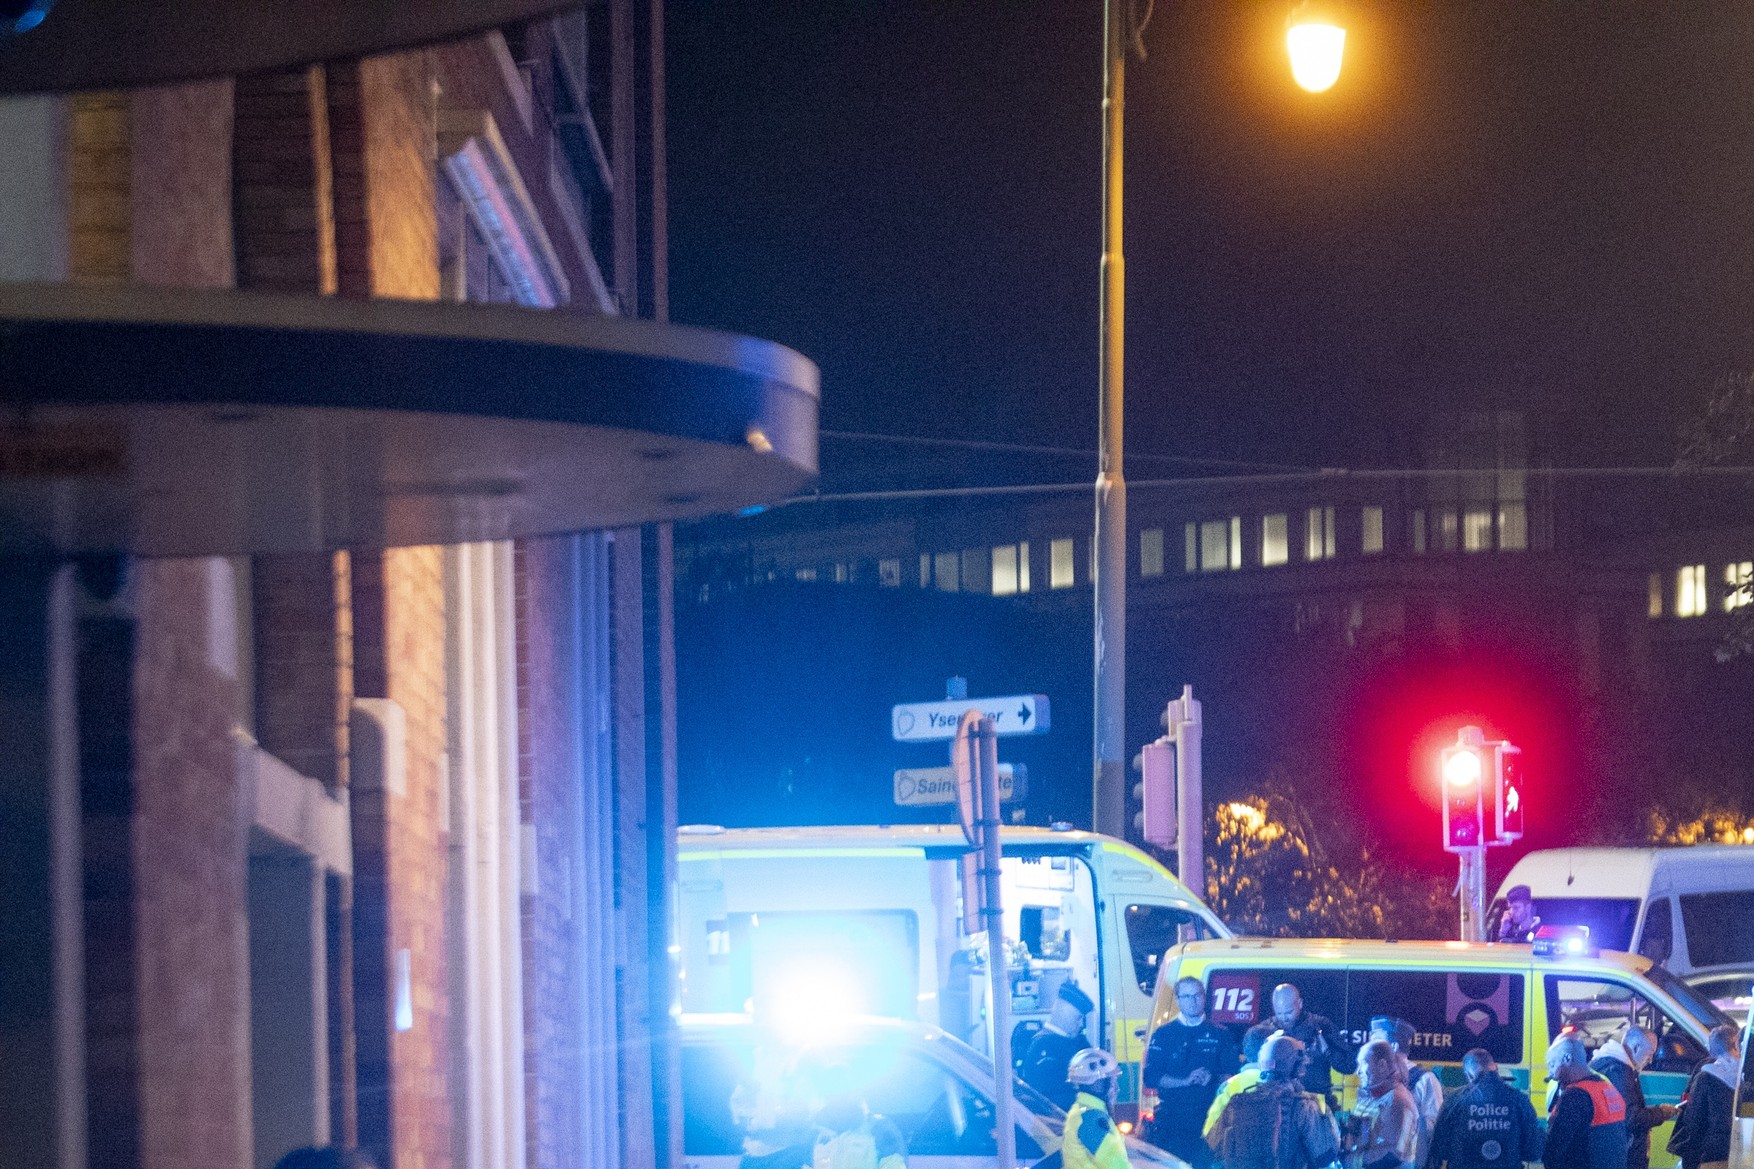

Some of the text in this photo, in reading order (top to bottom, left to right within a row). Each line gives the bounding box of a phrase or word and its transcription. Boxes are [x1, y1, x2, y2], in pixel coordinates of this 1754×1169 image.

[1213, 987, 1255, 1011] 112
[1469, 1104, 1509, 1117] Police
[1467, 1118, 1511, 1131] Politie
